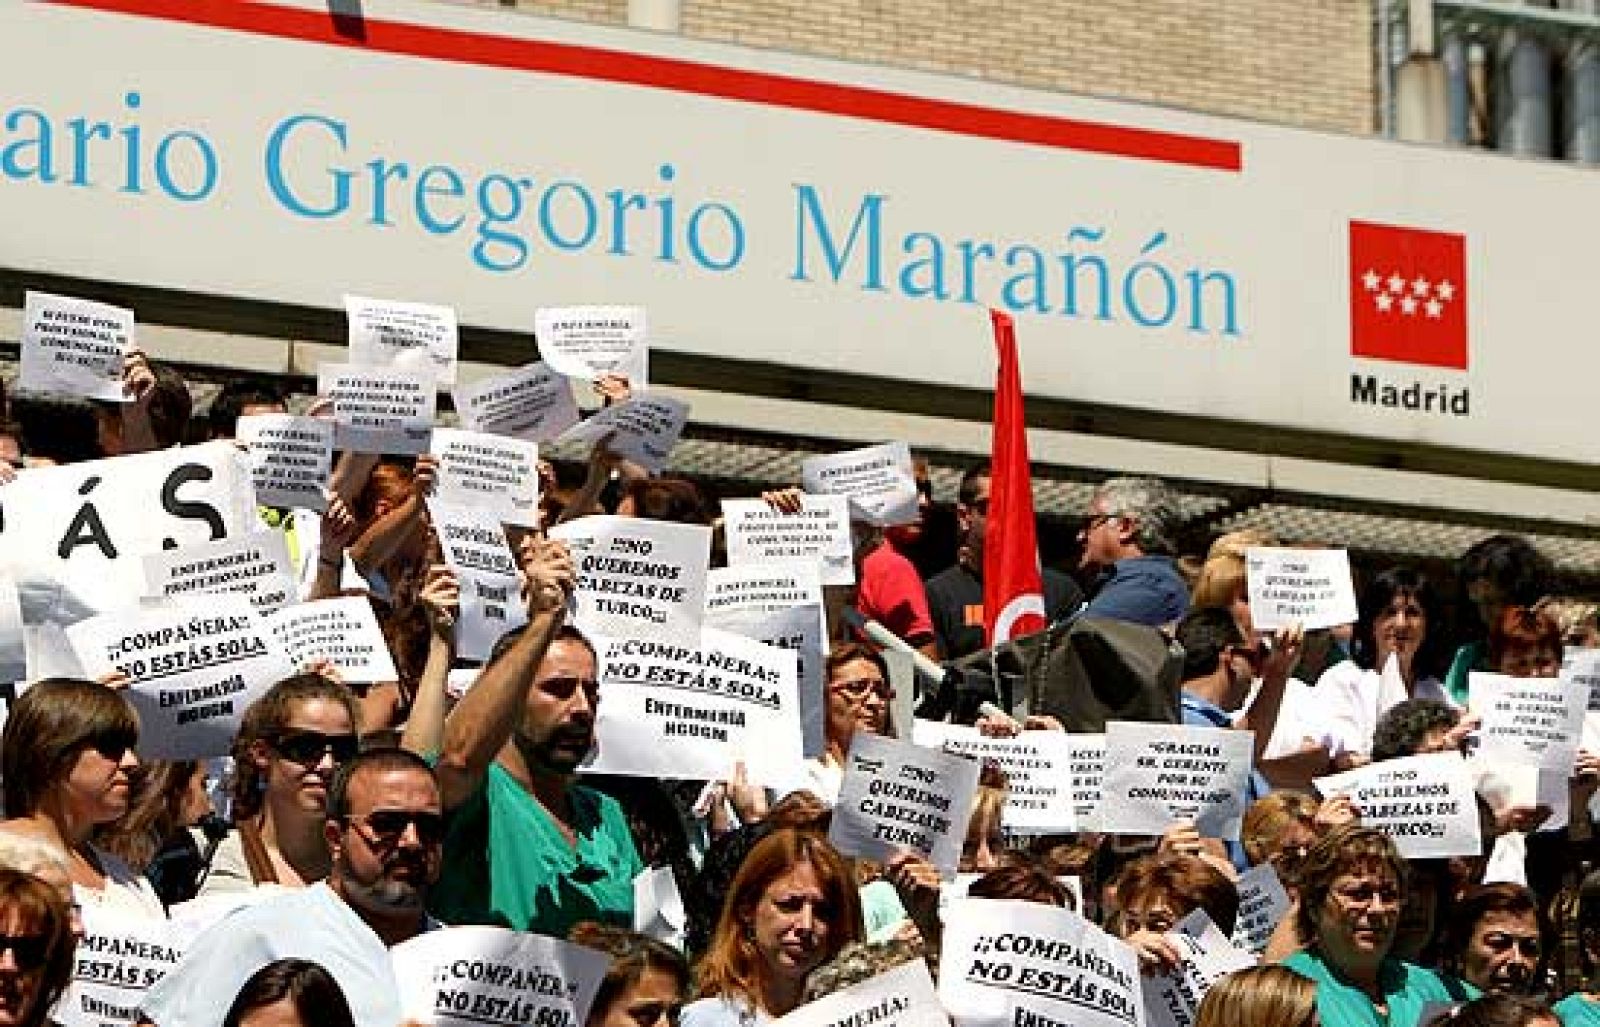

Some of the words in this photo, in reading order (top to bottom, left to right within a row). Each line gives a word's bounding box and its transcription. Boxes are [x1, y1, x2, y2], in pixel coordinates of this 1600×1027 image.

[0, 91, 218, 203] ario
[264, 113, 746, 272] Gregorio
[788, 182, 1242, 337] Marañón
[1350, 374, 1470, 416] Madrid
[581, 555, 682, 580] QUEREMOS
[659, 586, 688, 603] DE
[150, 643, 213, 673] ESTÁS
[217, 636, 266, 659] SOLA
[604, 662, 641, 679] NO
[645, 665, 722, 690] ESTÁS
[725, 680, 780, 706] SOLA
[645, 697, 745, 728] ENFERMERÍA
[1359, 782, 1451, 802] QUEREMOS
[1436, 800, 1461, 816] DE
[78, 959, 142, 985] ESTÁS
[967, 959, 1013, 982] NO
[1017, 968, 1098, 1002] ESTÁS
[435, 989, 470, 1011] NO
[471, 992, 535, 1022] ESTÁS
